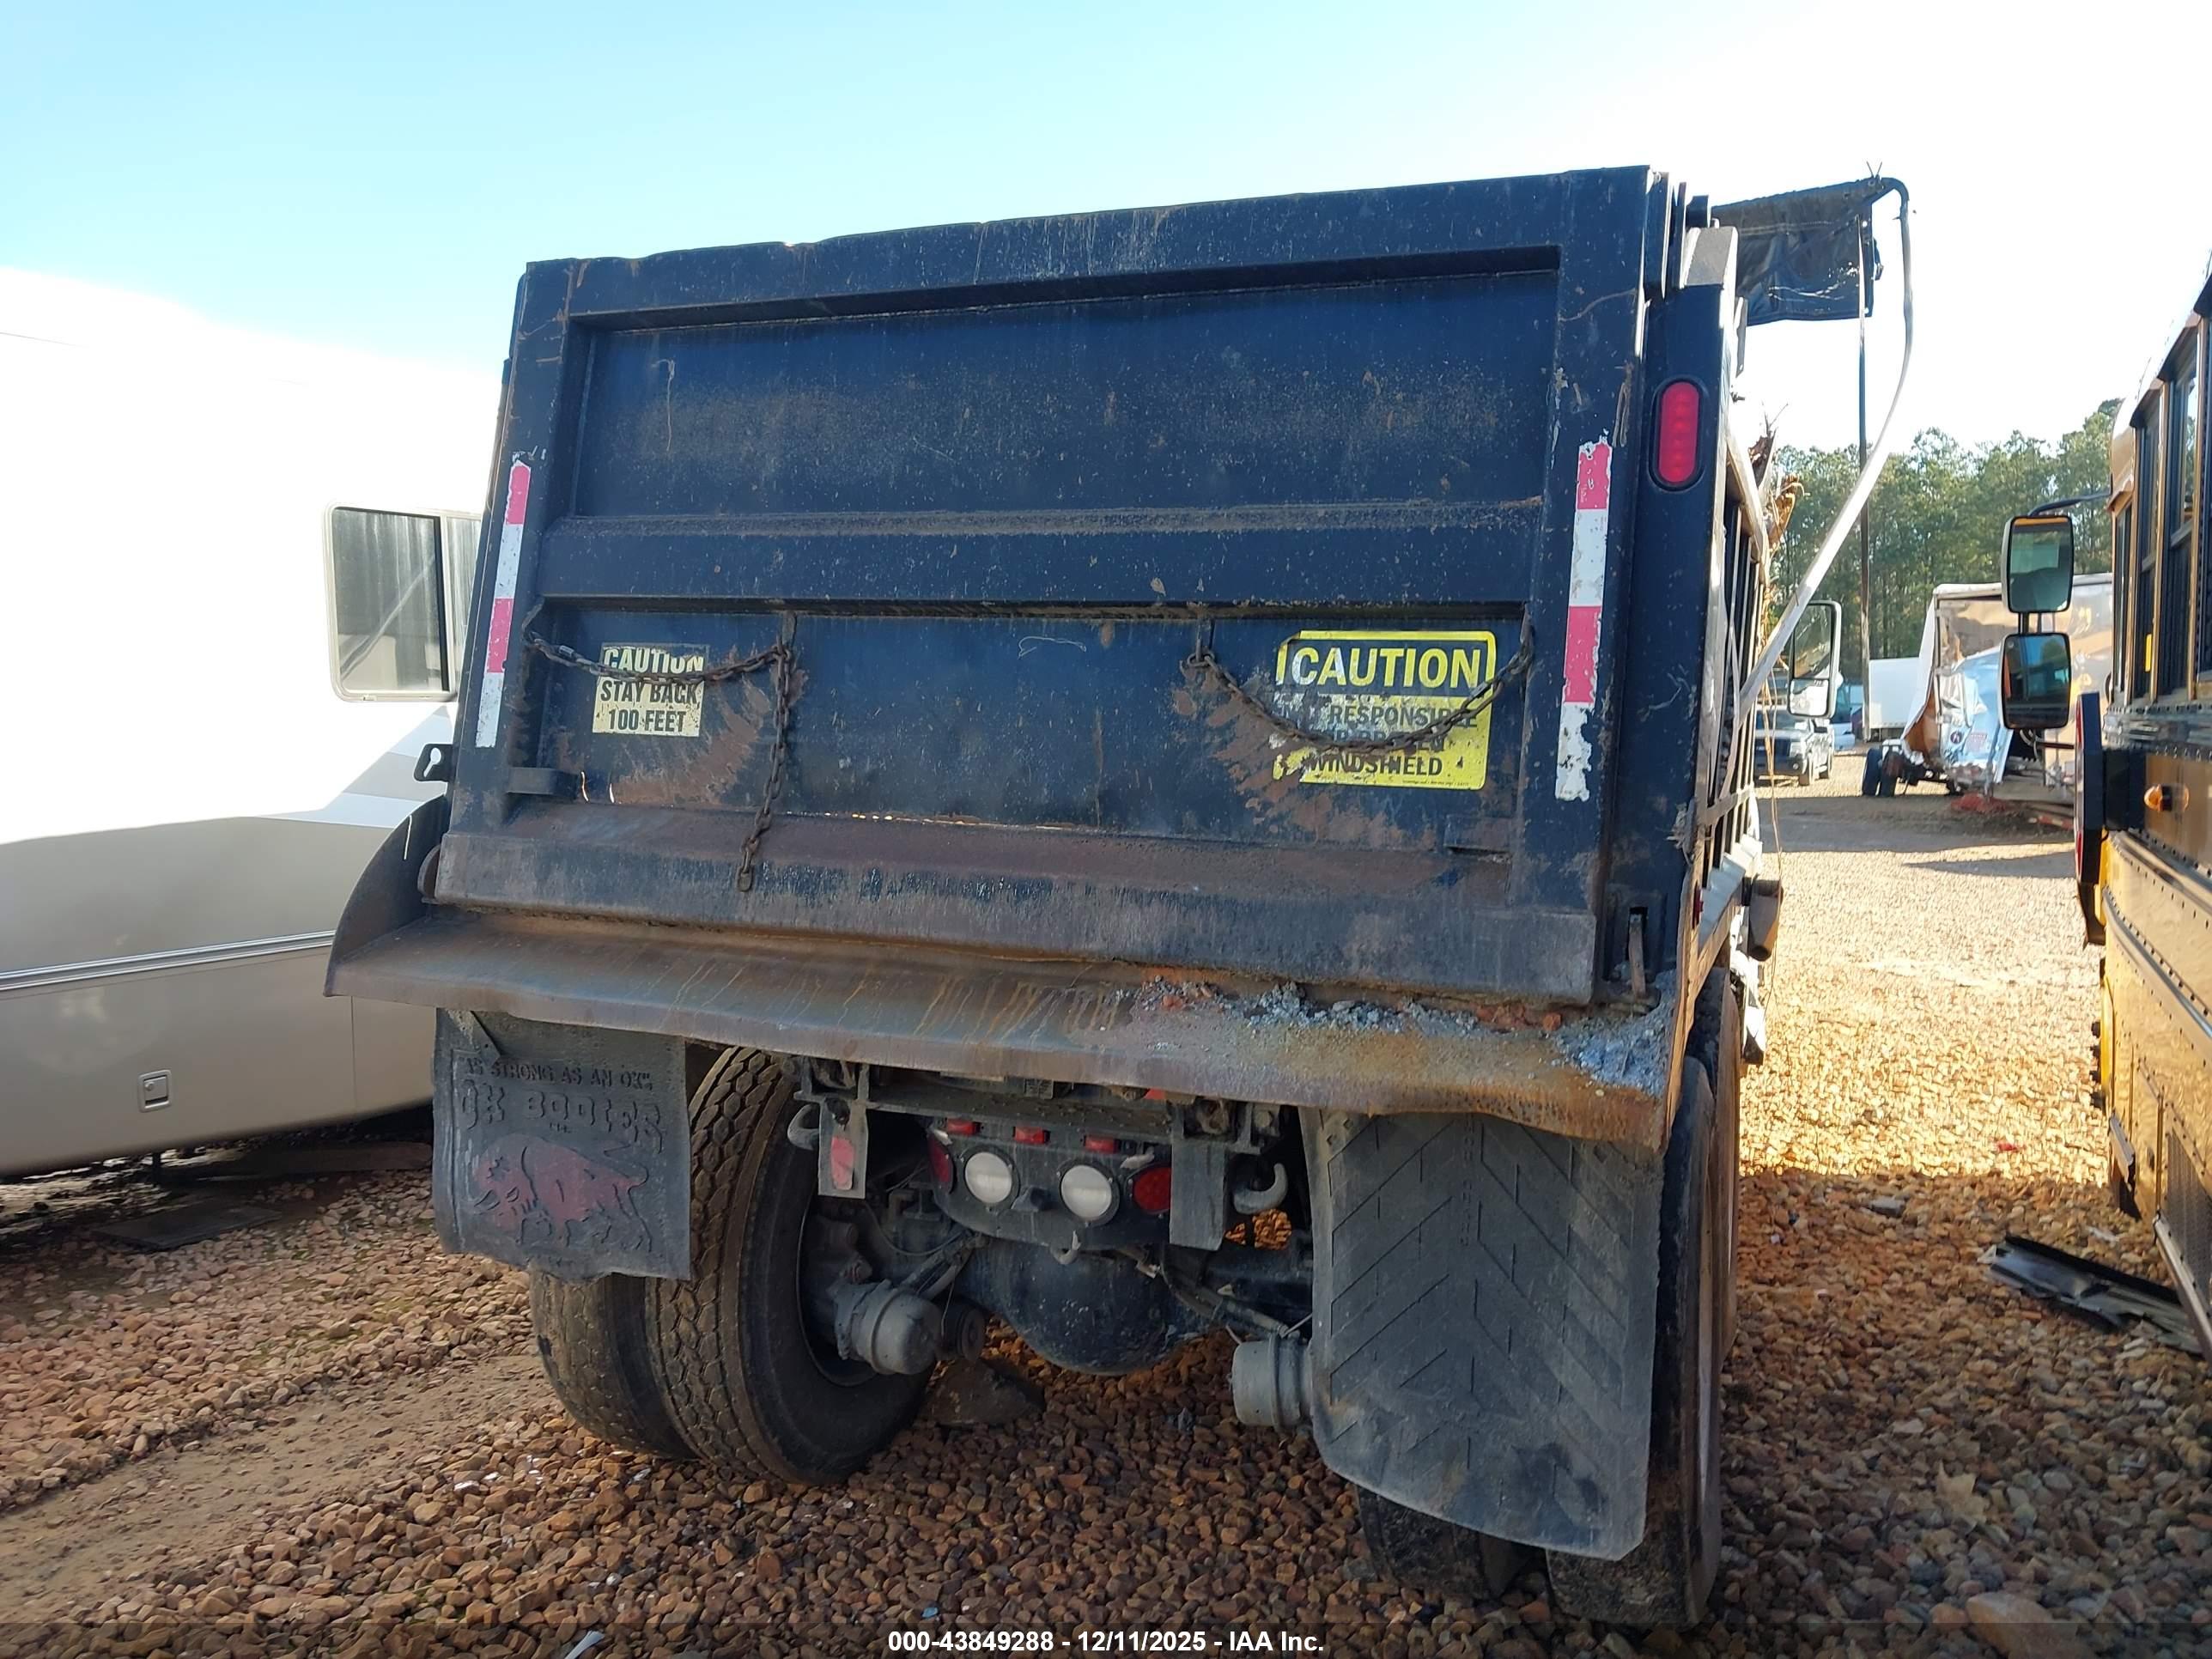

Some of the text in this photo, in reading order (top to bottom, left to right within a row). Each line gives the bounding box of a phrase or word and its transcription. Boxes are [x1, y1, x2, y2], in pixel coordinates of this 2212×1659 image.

[604, 648, 704, 674] CAUTION
[1291, 647, 1481, 688] CAUTION
[601, 680, 697, 704] STAY BACK
[608, 708, 687, 732] 100 FEET
